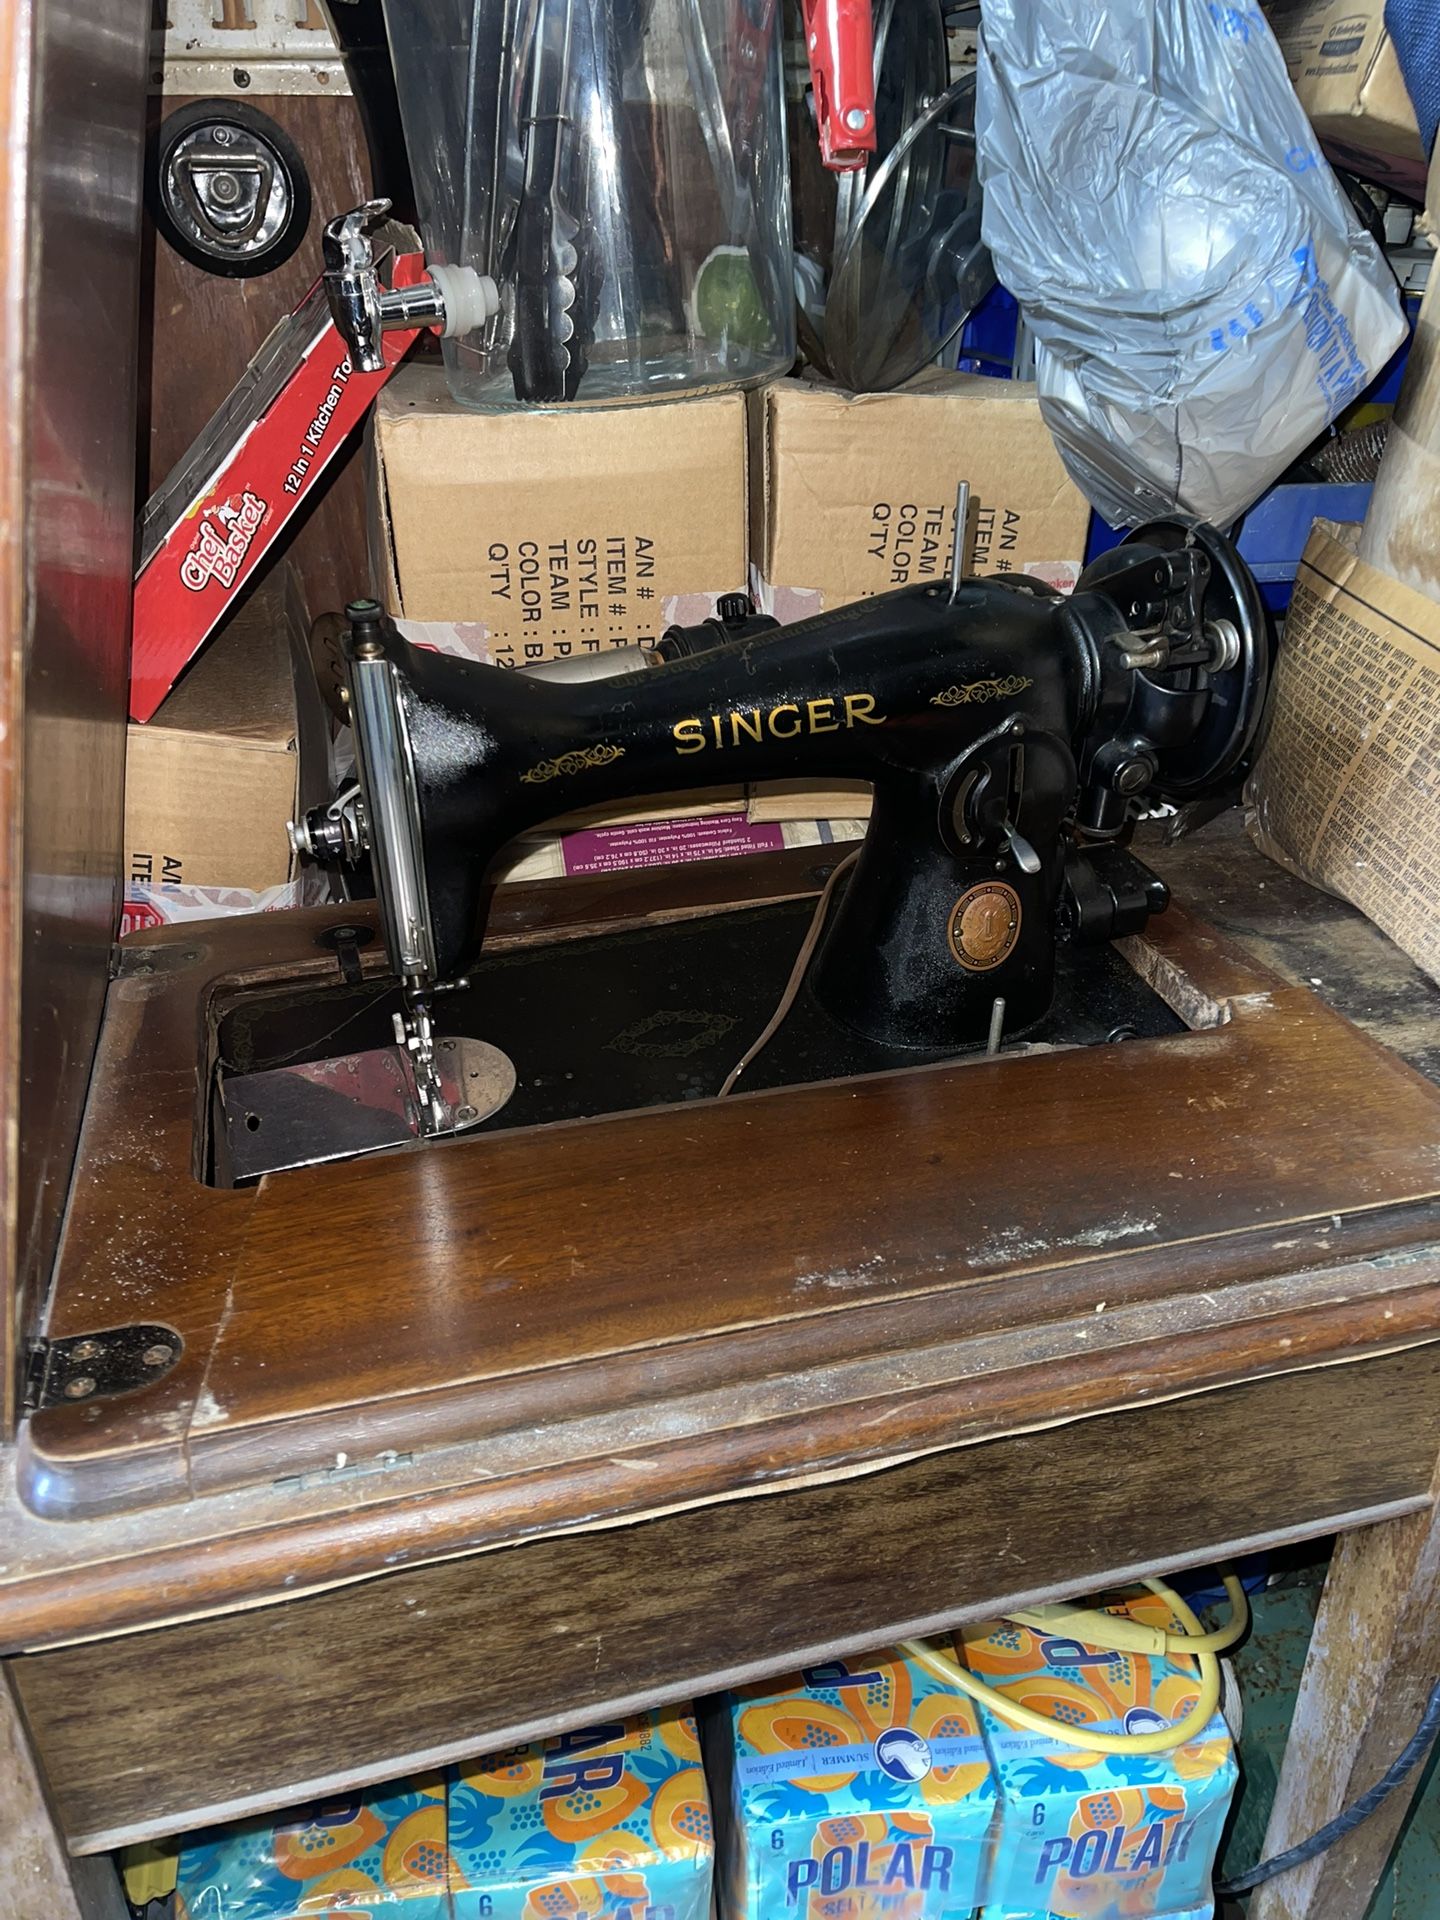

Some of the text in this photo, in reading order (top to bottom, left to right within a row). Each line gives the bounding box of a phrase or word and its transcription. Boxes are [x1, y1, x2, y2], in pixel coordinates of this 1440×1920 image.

[306, 382, 343, 448] Kitchen
[296, 456, 310, 475] In
[302, 444, 316, 457] 1
[283, 473, 302, 496] 12
[180, 519, 223, 592] Chef
[210, 491, 268, 588] Basket
[635, 536, 654, 577] A/N
[868, 503, 891, 560] Q'TY
[890, 504, 918, 584] COLOR
[918, 505, 944, 574] TEAM
[971, 508, 996, 565] ITEM
[996, 509, 1021, 572] A/N #
[488, 543, 511, 600] Q'TY
[518, 541, 542, 622] COLOR
[548, 539, 570, 610] TEAM
[577, 539, 599, 618] STYLE
[606, 537, 627, 595] ITEM
[636, 586, 654, 600] #
[1049, 578, 1075, 588] oken
[608, 603, 627, 616] #
[673, 693, 887, 755] SINGER
[821, 1751, 869, 1765] SUMMER
[771, 1829, 785, 1850] 6
[1031, 1802, 1045, 1826] 6
[786, 1841, 955, 1907] POLAR
[1034, 1821, 1195, 1885] POLAR
[478, 1894, 492, 1918] 6
